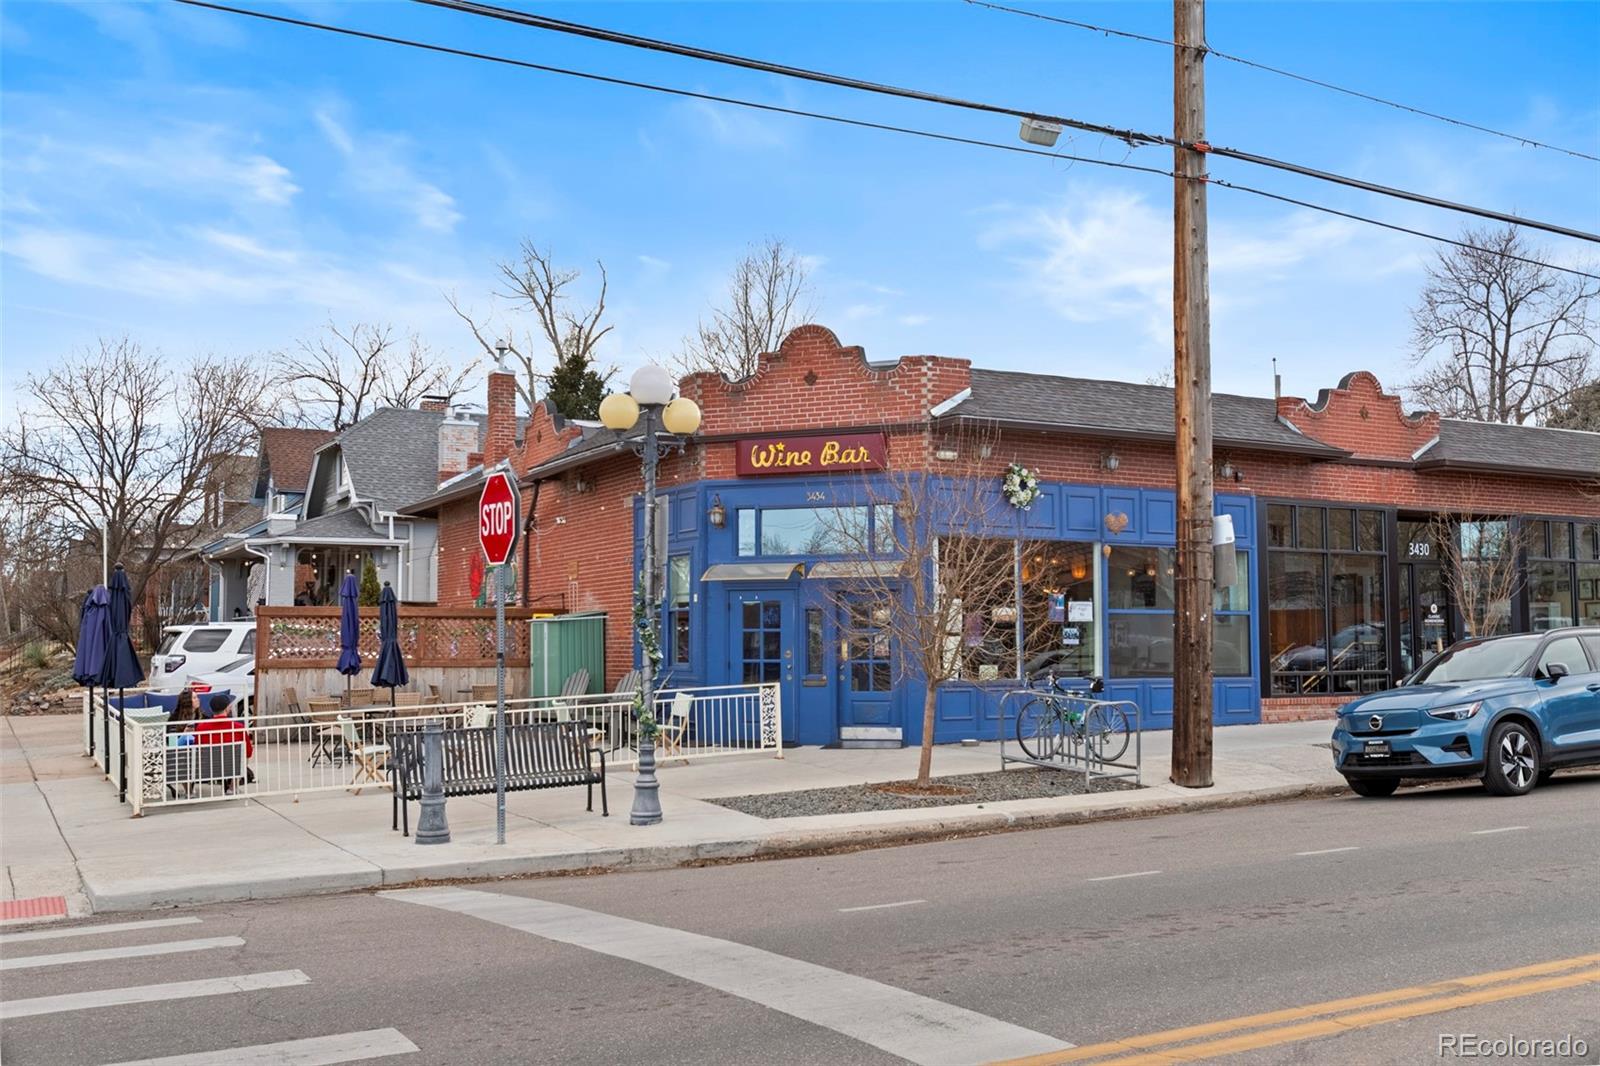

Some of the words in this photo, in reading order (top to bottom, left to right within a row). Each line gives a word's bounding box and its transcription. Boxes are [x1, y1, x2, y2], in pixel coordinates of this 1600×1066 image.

[751, 442, 811, 468] Wine
[820, 441, 871, 466] Bar
[482, 501, 512, 536] STOP
[1408, 542, 1430, 556] 3430
